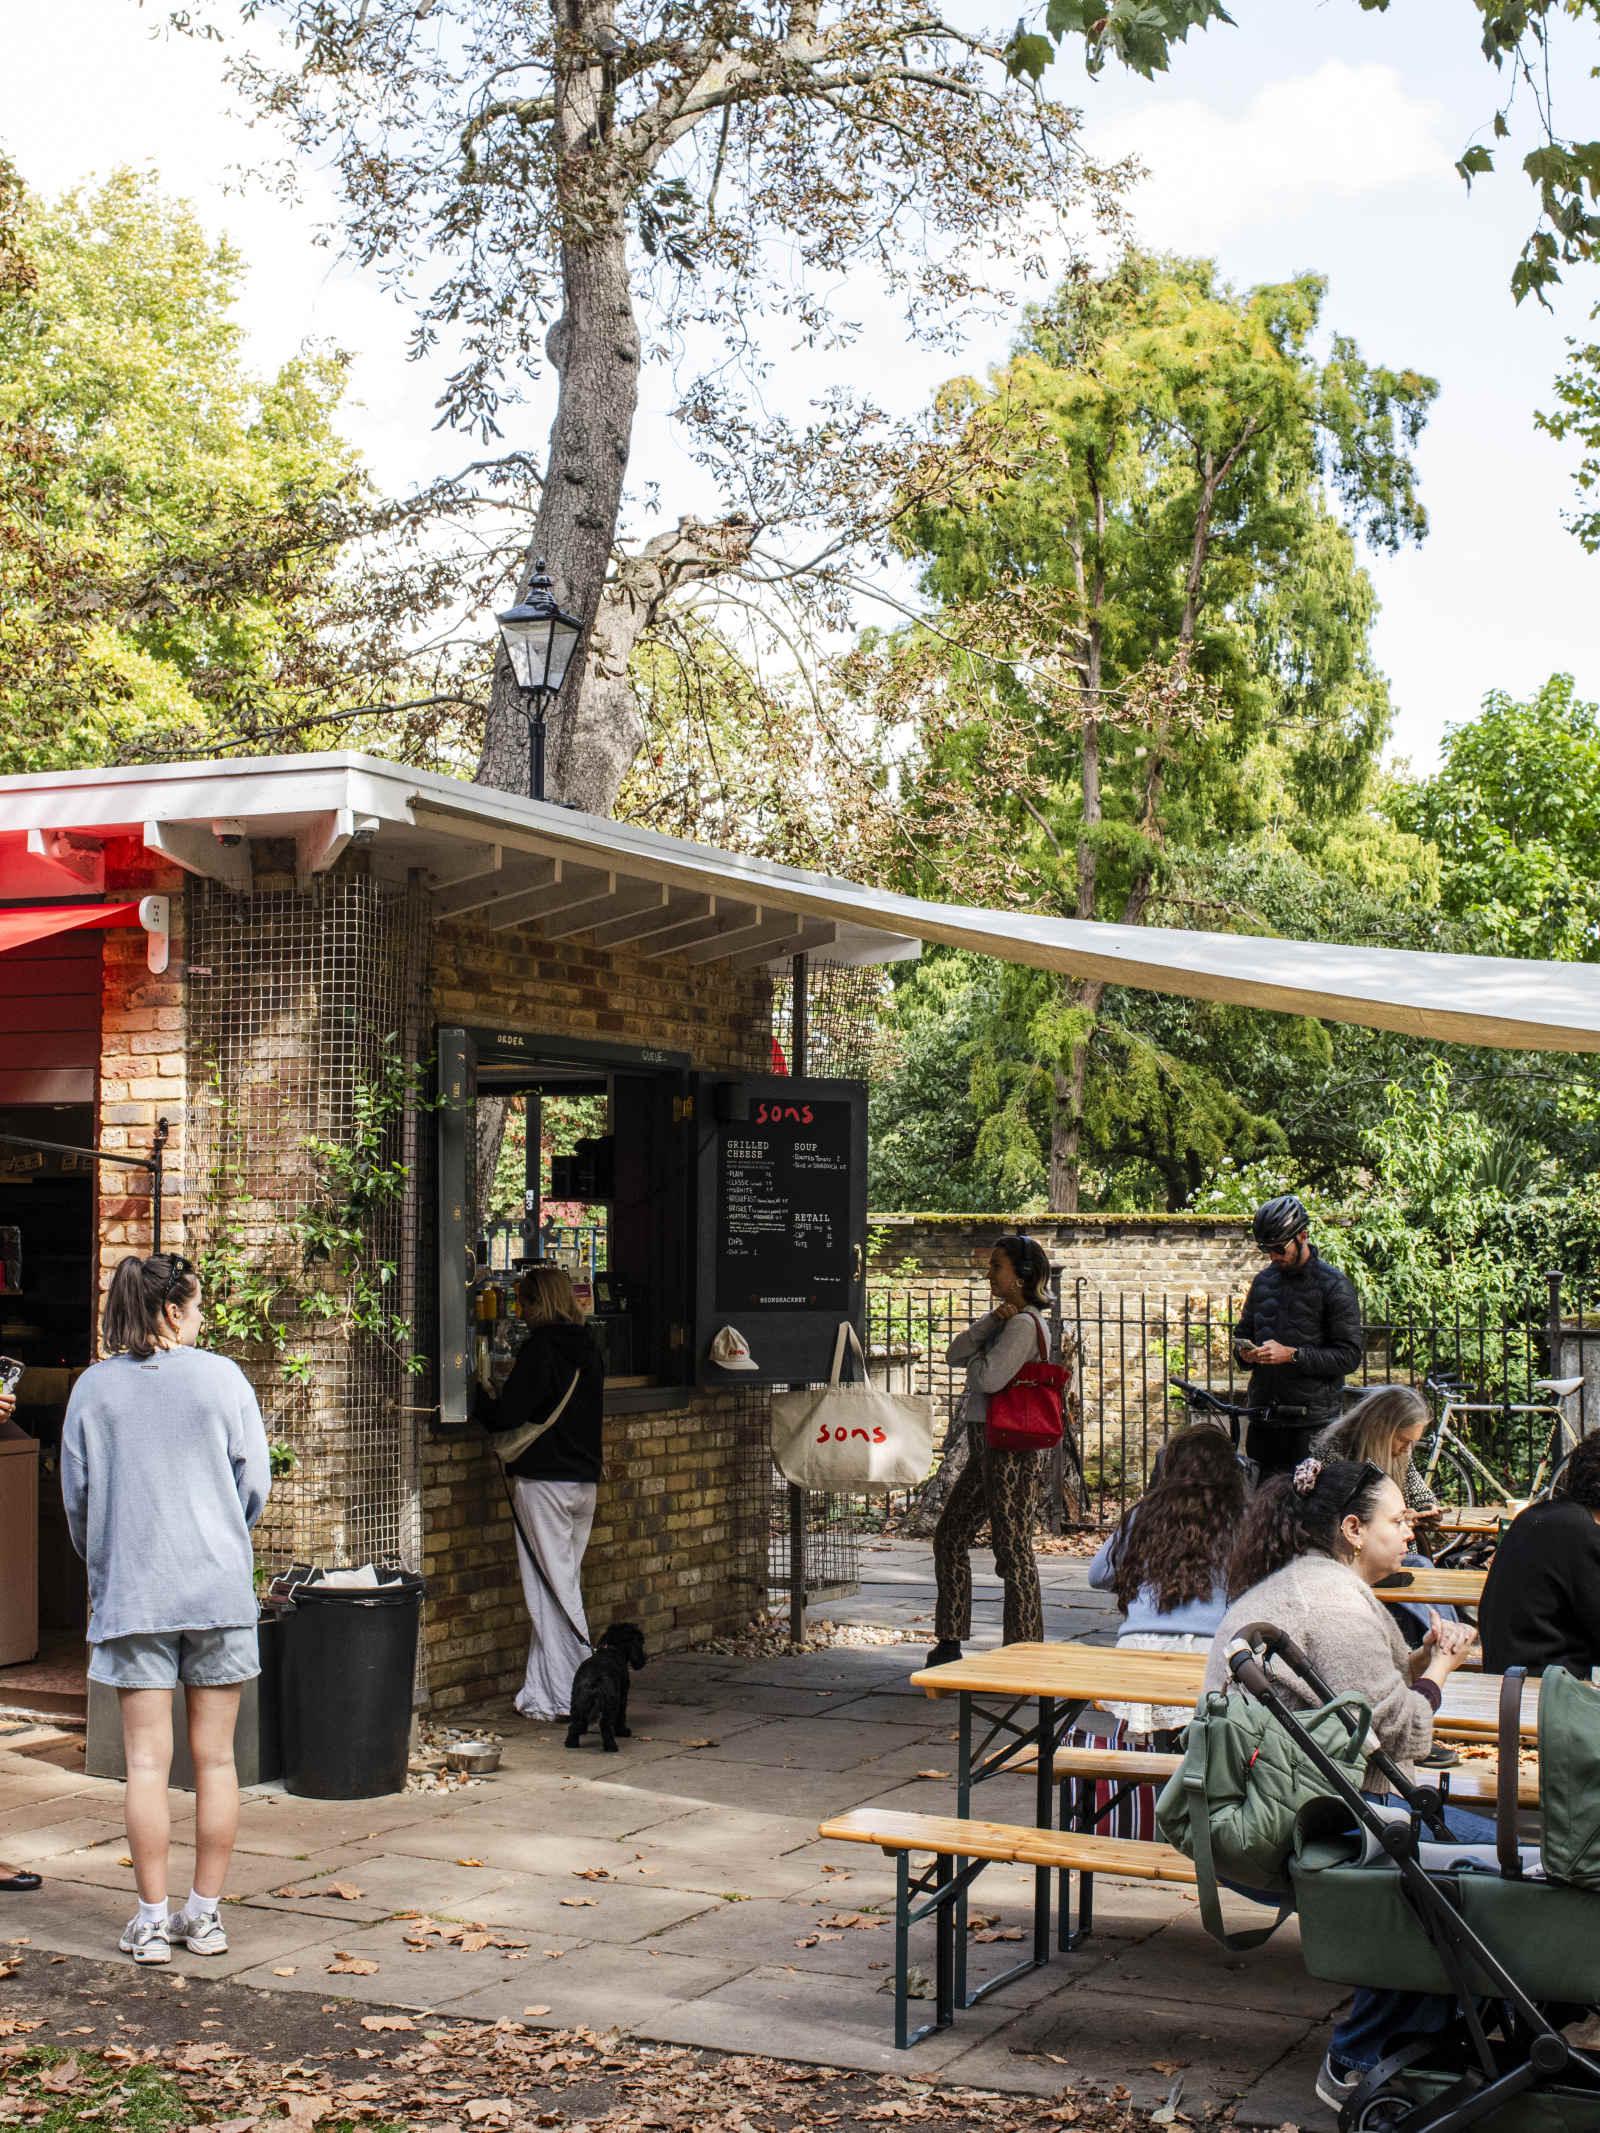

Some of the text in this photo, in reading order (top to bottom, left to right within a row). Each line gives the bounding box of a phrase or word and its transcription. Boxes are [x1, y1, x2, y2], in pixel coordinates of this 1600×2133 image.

[497, 1034, 525, 1046] ORDER
[756, 1103, 814, 1124] sons
[727, 1140, 769, 1150] GRILLED
[794, 1142, 818, 1151] SOUP
[727, 1149, 763, 1159] CHEESE
[794, 1213, 830, 1222] RETAIL
[816, 1423, 887, 1443] sons
